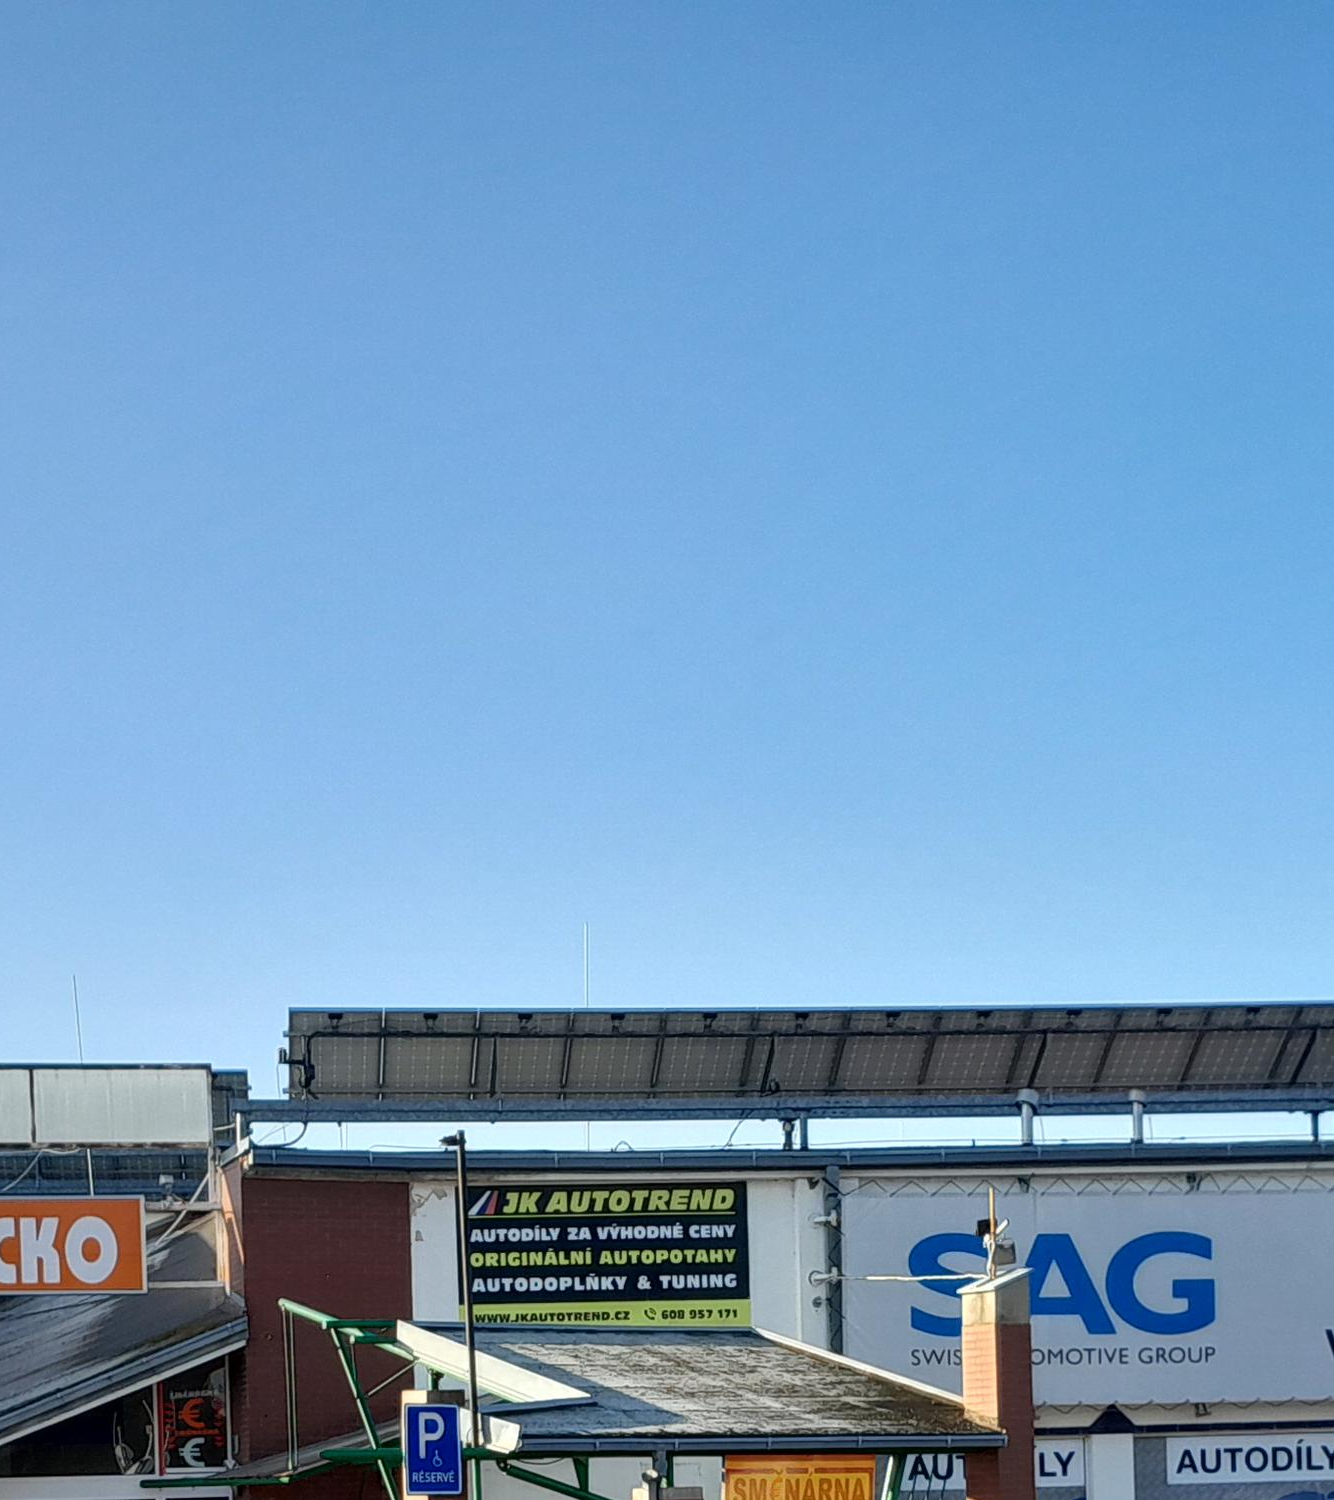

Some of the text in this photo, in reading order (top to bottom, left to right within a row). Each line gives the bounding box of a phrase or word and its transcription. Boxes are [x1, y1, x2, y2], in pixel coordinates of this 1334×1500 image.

[502, 1187, 735, 1214] JK AUTOTREND
[470, 1222, 737, 1243] AUTODÍLY ZA VÝHODNÉ CENY
[470, 1247, 737, 1268] ORIGINÁLNÍ AUTOPOTAHY
[471, 1273, 738, 1293] AUTODOPLŇKY & TUNING
[908, 1230, 1216, 1337] SAG
[474, 1308, 738, 1324] WWW.JKAUTOTREND.CZ 608 957 171
[910, 1348, 962, 1366] SWIS
[1138, 1346, 1216, 1364] GROUP
[418, 1411, 445, 1459] P
